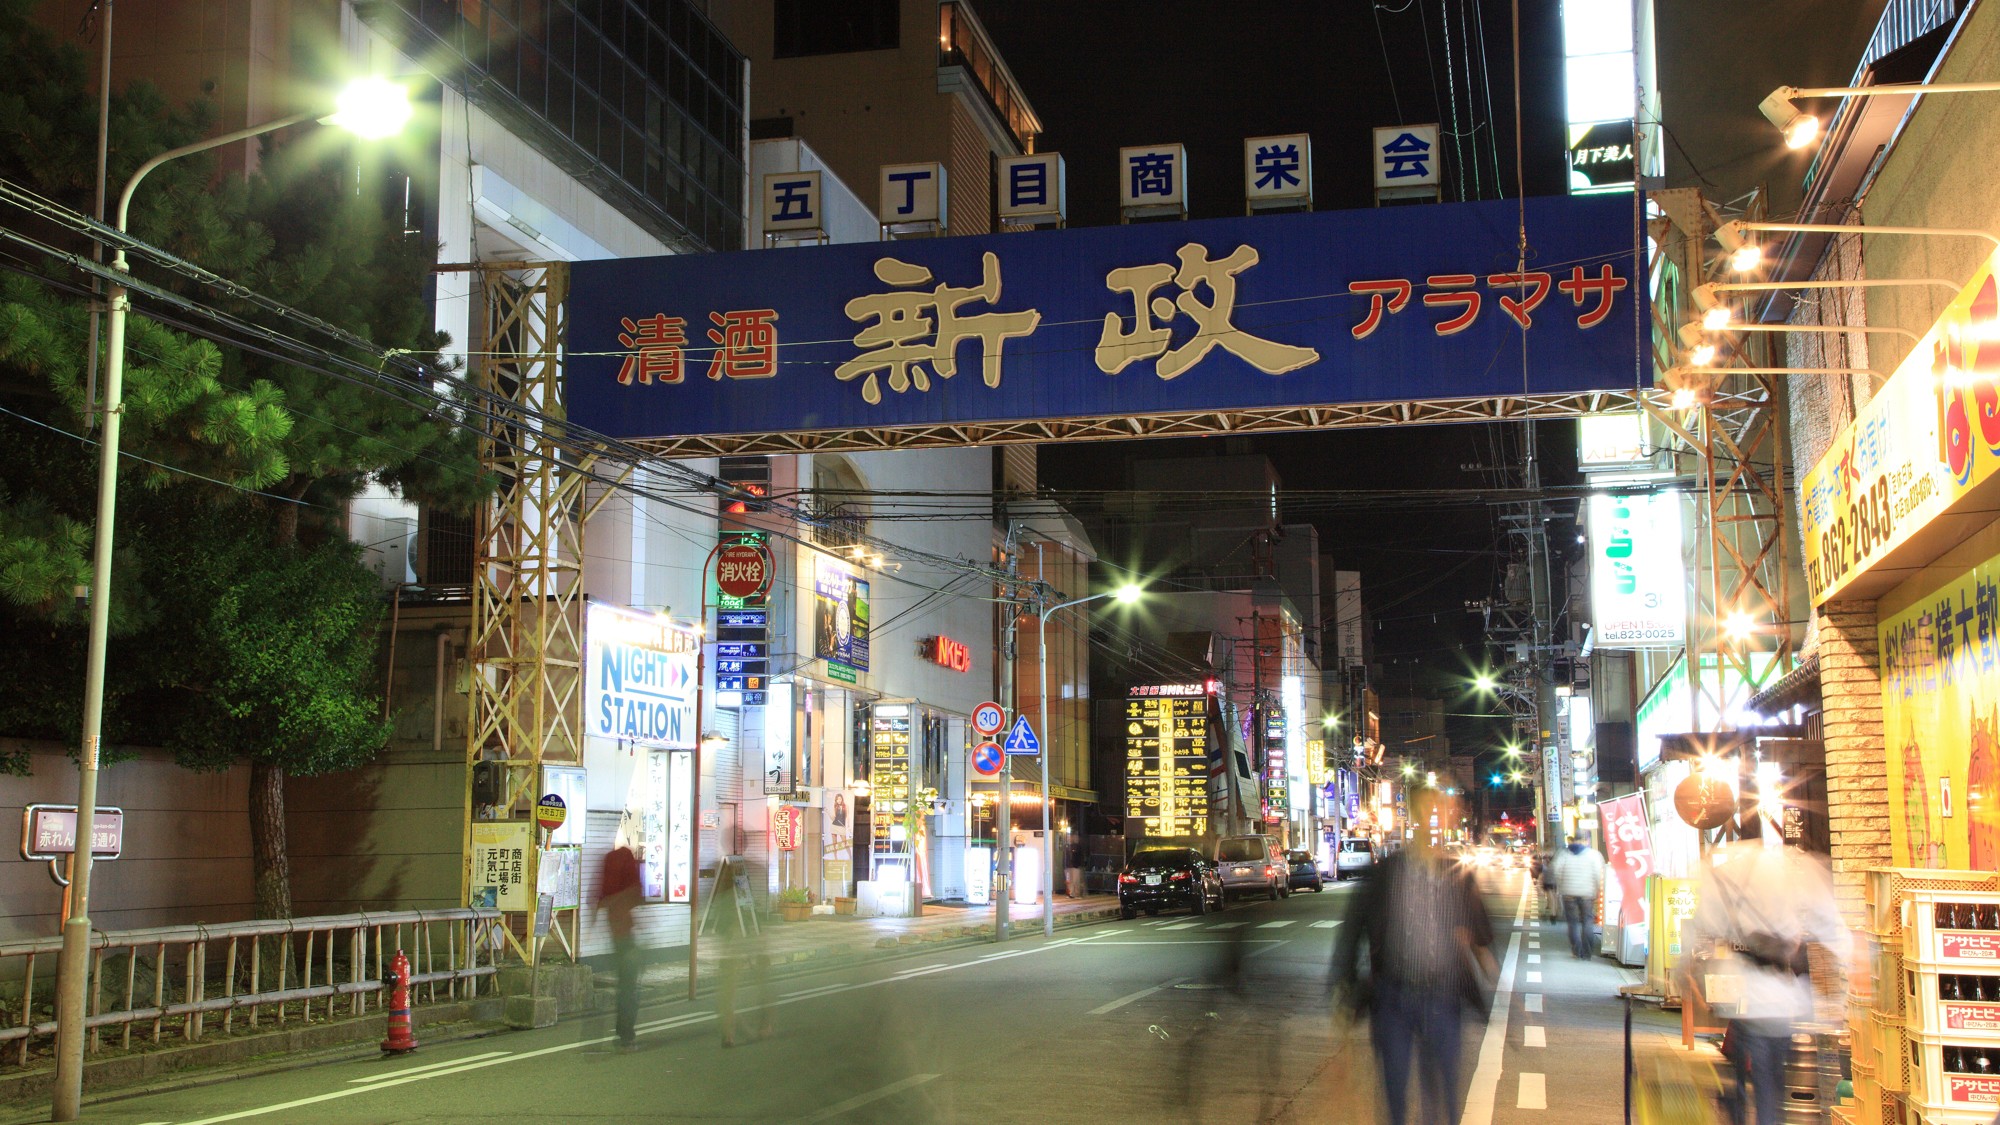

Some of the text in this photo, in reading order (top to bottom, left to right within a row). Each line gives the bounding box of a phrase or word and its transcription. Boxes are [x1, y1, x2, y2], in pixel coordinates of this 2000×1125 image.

[1574, 143, 1634, 166] 月下美人
[616, 308, 779, 385] 清酒
[1348, 263, 1628, 340] アラマサ
[720, 561, 761, 582] 消火栓
[601, 643, 667, 693] NIGHT
[979, 711, 998, 727] 30
[539, 807, 565, 817] 大町五丁目
[40, 831, 117, 848] 赤れん通り
[775, 810, 792, 848] 居酒屋
[486, 848, 498, 883] 元気に
[498, 848, 509, 896] 町工場を
[511, 848, 522, 884] 商店街
[1944, 935, 2000, 948] アサヒビー
